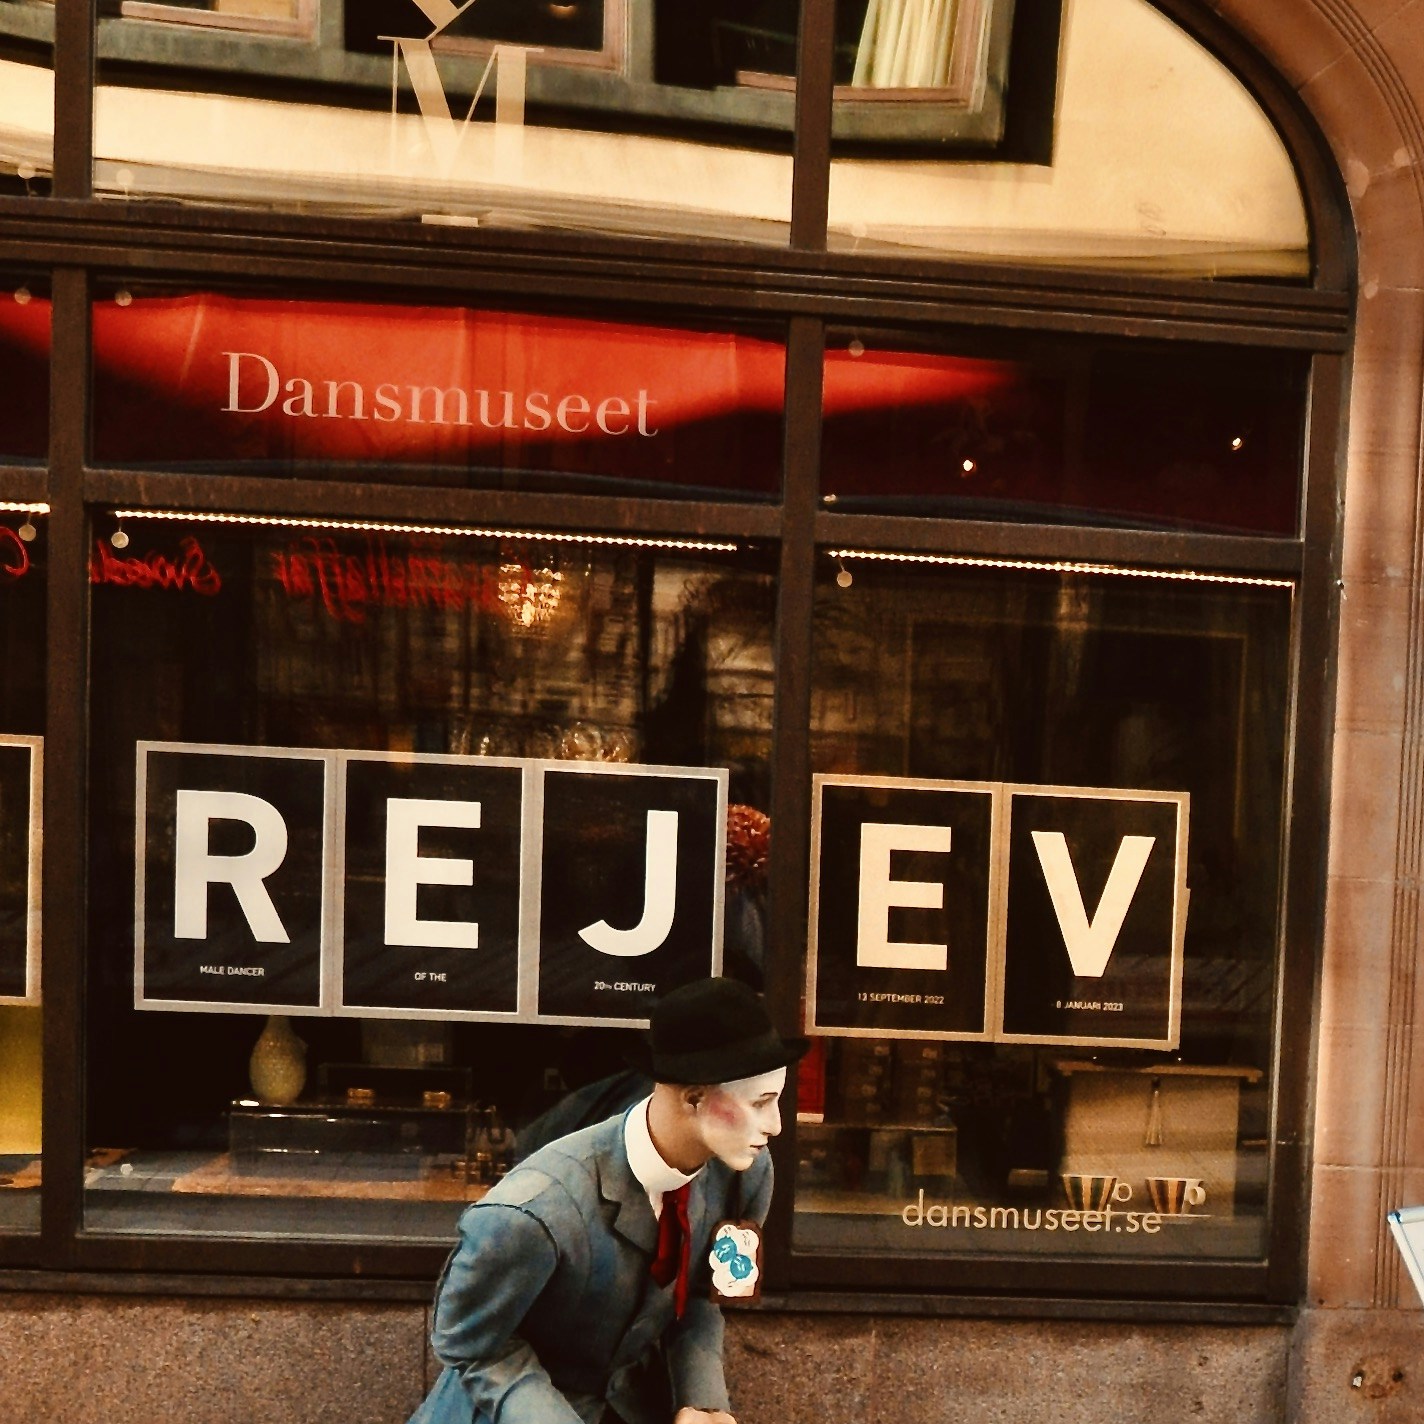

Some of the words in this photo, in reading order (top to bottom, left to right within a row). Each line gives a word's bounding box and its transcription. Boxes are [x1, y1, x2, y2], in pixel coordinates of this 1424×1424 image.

[220, 351, 659, 438] Dansmuseet
[199, 965, 225, 976] MALE
[227, 966, 265, 977] DANCER
[414, 972, 427, 981] OF
[429, 972, 447, 982] THE
[613, 982, 656, 992] CENTURY
[869, 992, 922, 1003] SEPTEMBER
[924, 995, 945, 1005] 2022
[1064, 1001, 1102, 1010] JANUARI
[1103, 1002, 1124, 1012] 2023
[902, 1188, 1163, 1235] dansmuseet.se
